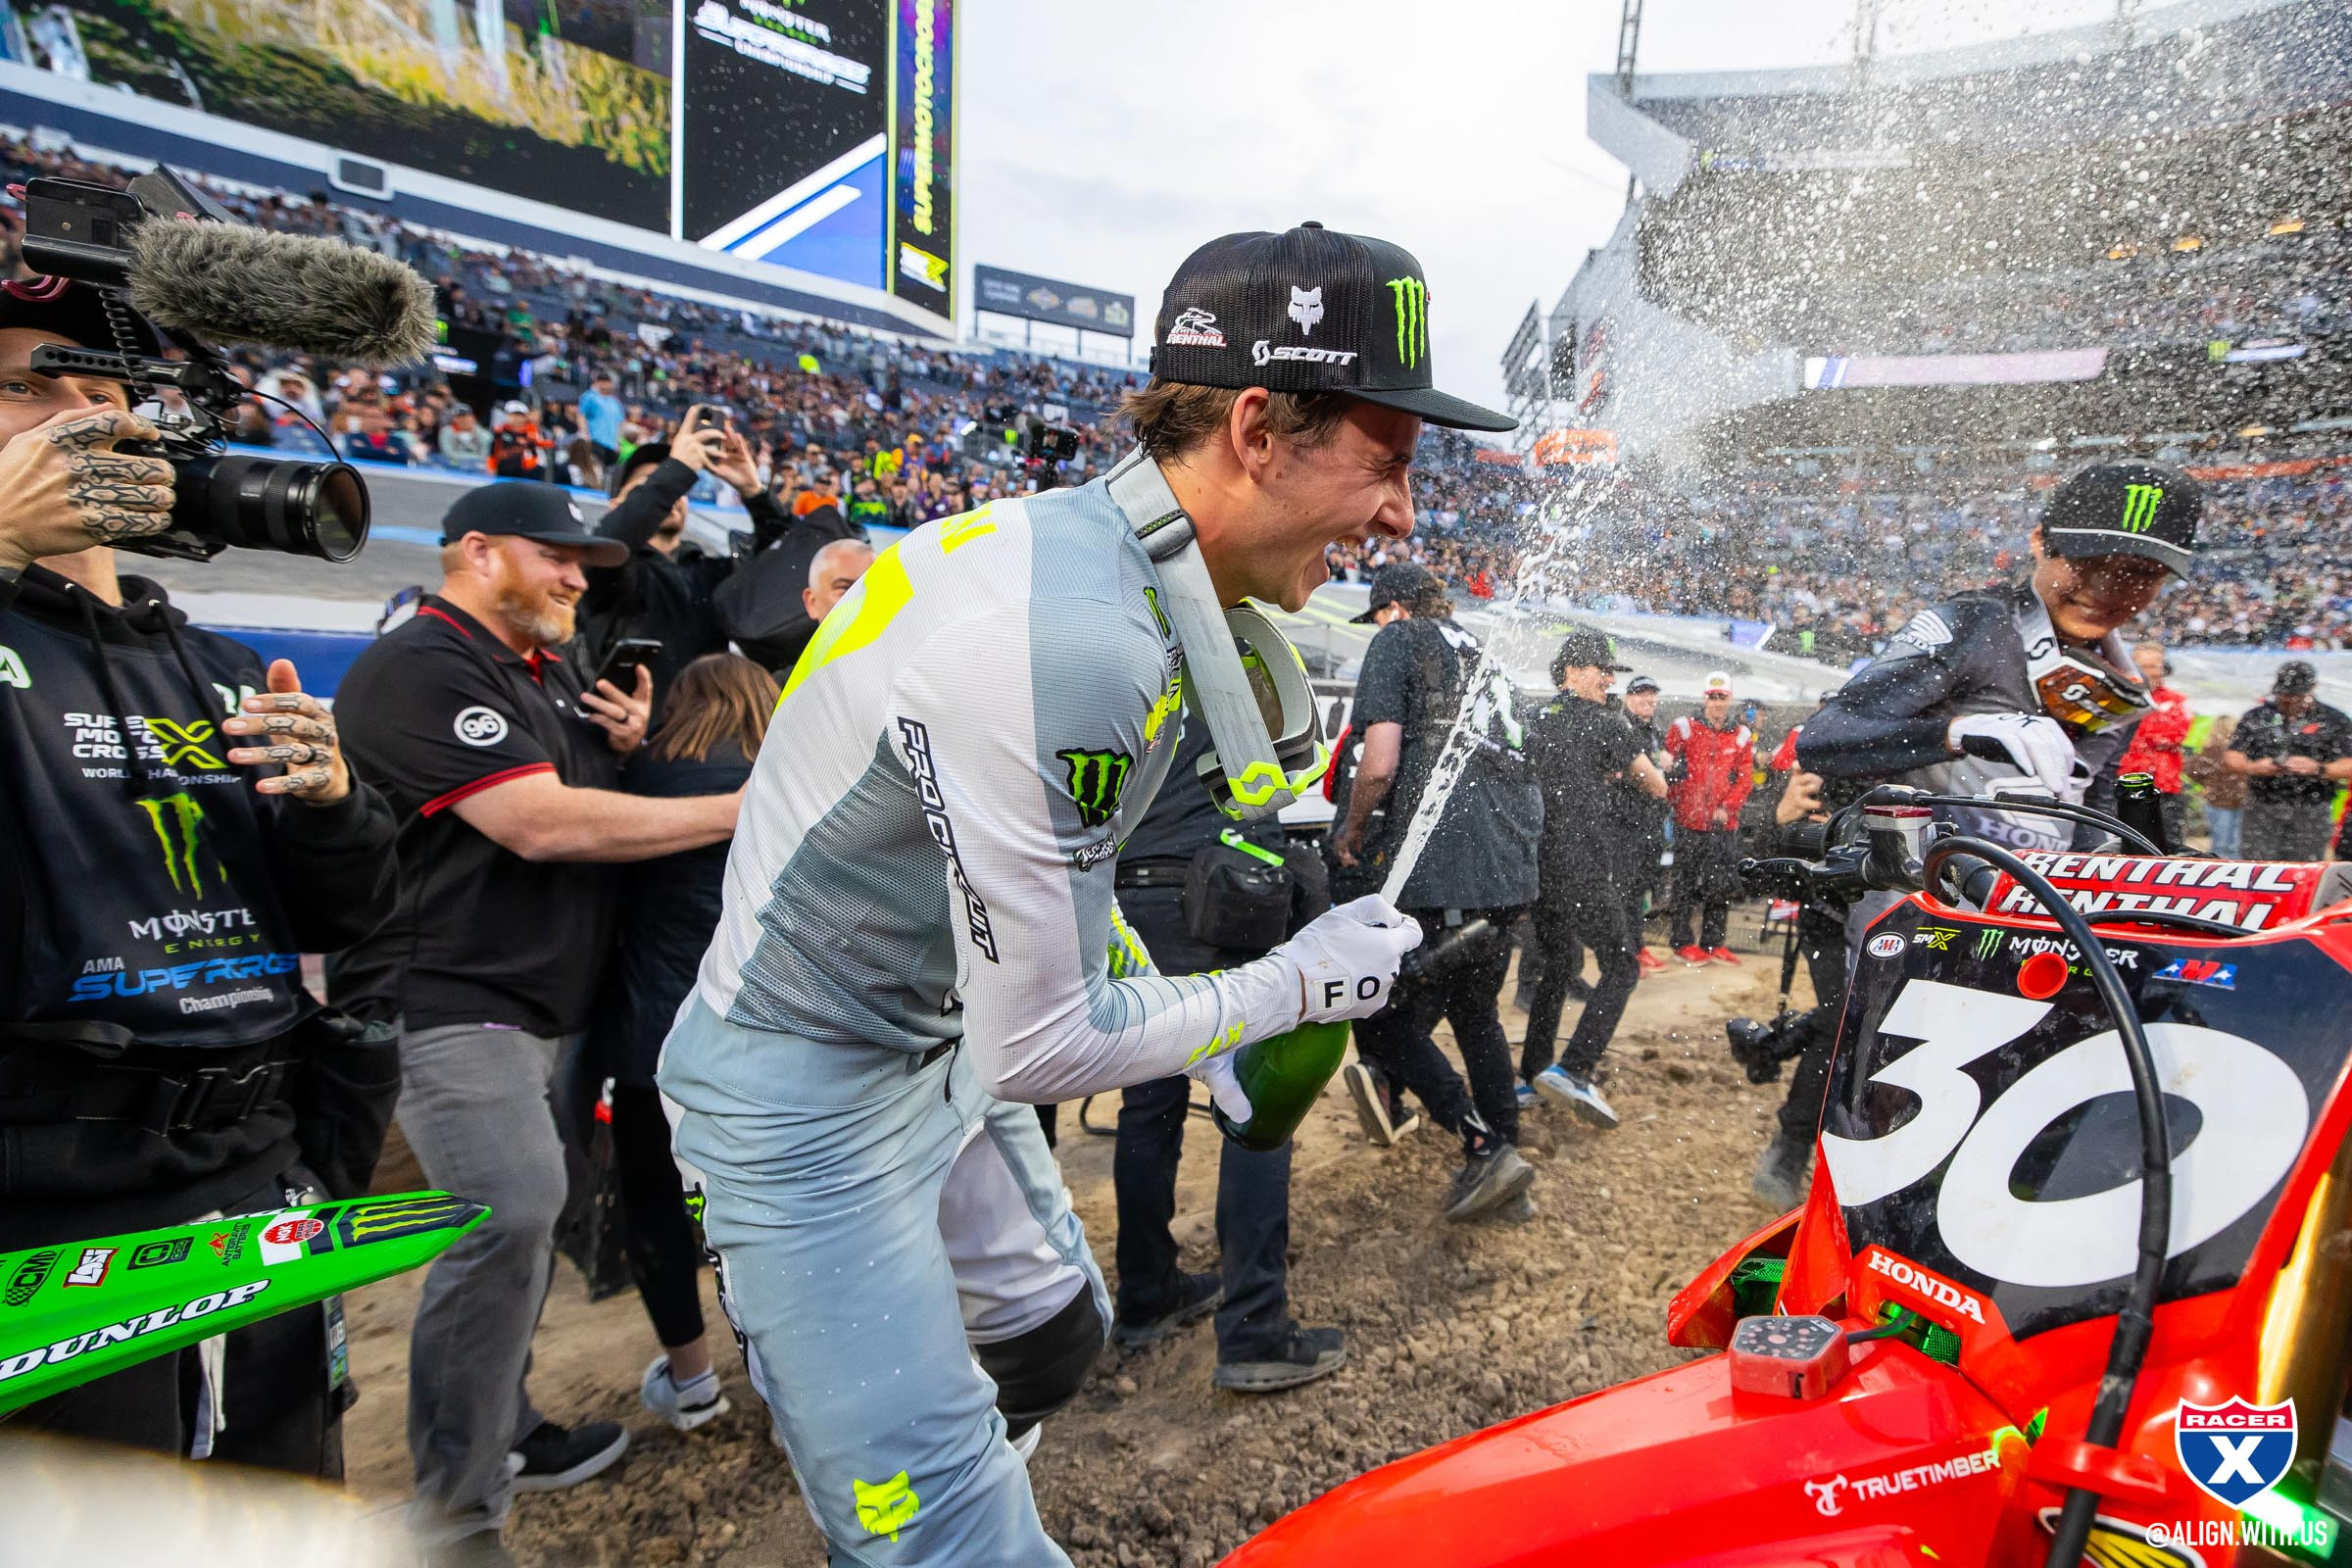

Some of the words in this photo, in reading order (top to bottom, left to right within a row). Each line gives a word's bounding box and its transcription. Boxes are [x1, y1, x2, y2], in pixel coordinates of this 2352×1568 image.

[913, 0, 935, 235] SUPERMOTOCROS
[1166, 333, 1226, 347] RENTHAL
[1272, 346, 1358, 366] SCOTT
[2025, 854, 2295, 891] RENTHAL
[1913, 930, 1957, 951] SMX
[82, 956, 125, 974] AMA
[1821, 978, 2311, 1288] 30
[276, 1224, 293, 1242] NGK
[1868, 1250, 1986, 1325] HONDA
[0, 1279, 270, 1380] DUNLOP
[1849, 1448, 2001, 1502] TRUETIMBER
